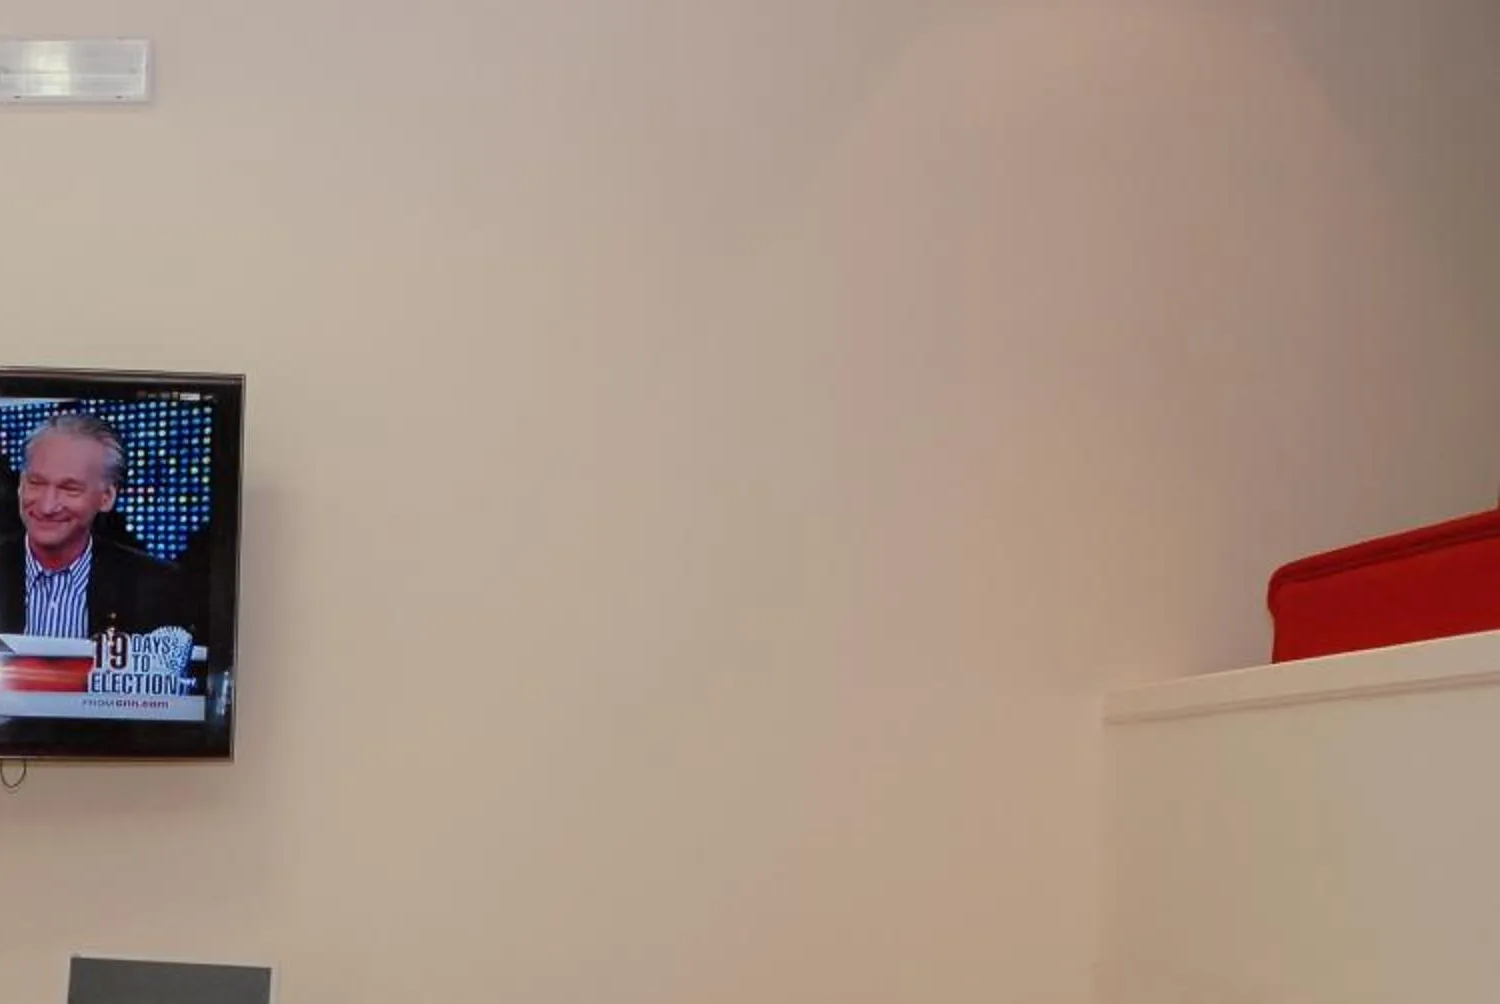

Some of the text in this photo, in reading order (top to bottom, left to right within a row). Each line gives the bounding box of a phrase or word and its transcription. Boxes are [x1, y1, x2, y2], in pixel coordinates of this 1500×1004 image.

[93, 631, 130, 671] 19
[131, 634, 172, 654] DAYS
[132, 653, 152, 674] TO
[90, 672, 179, 695] ELECTION
